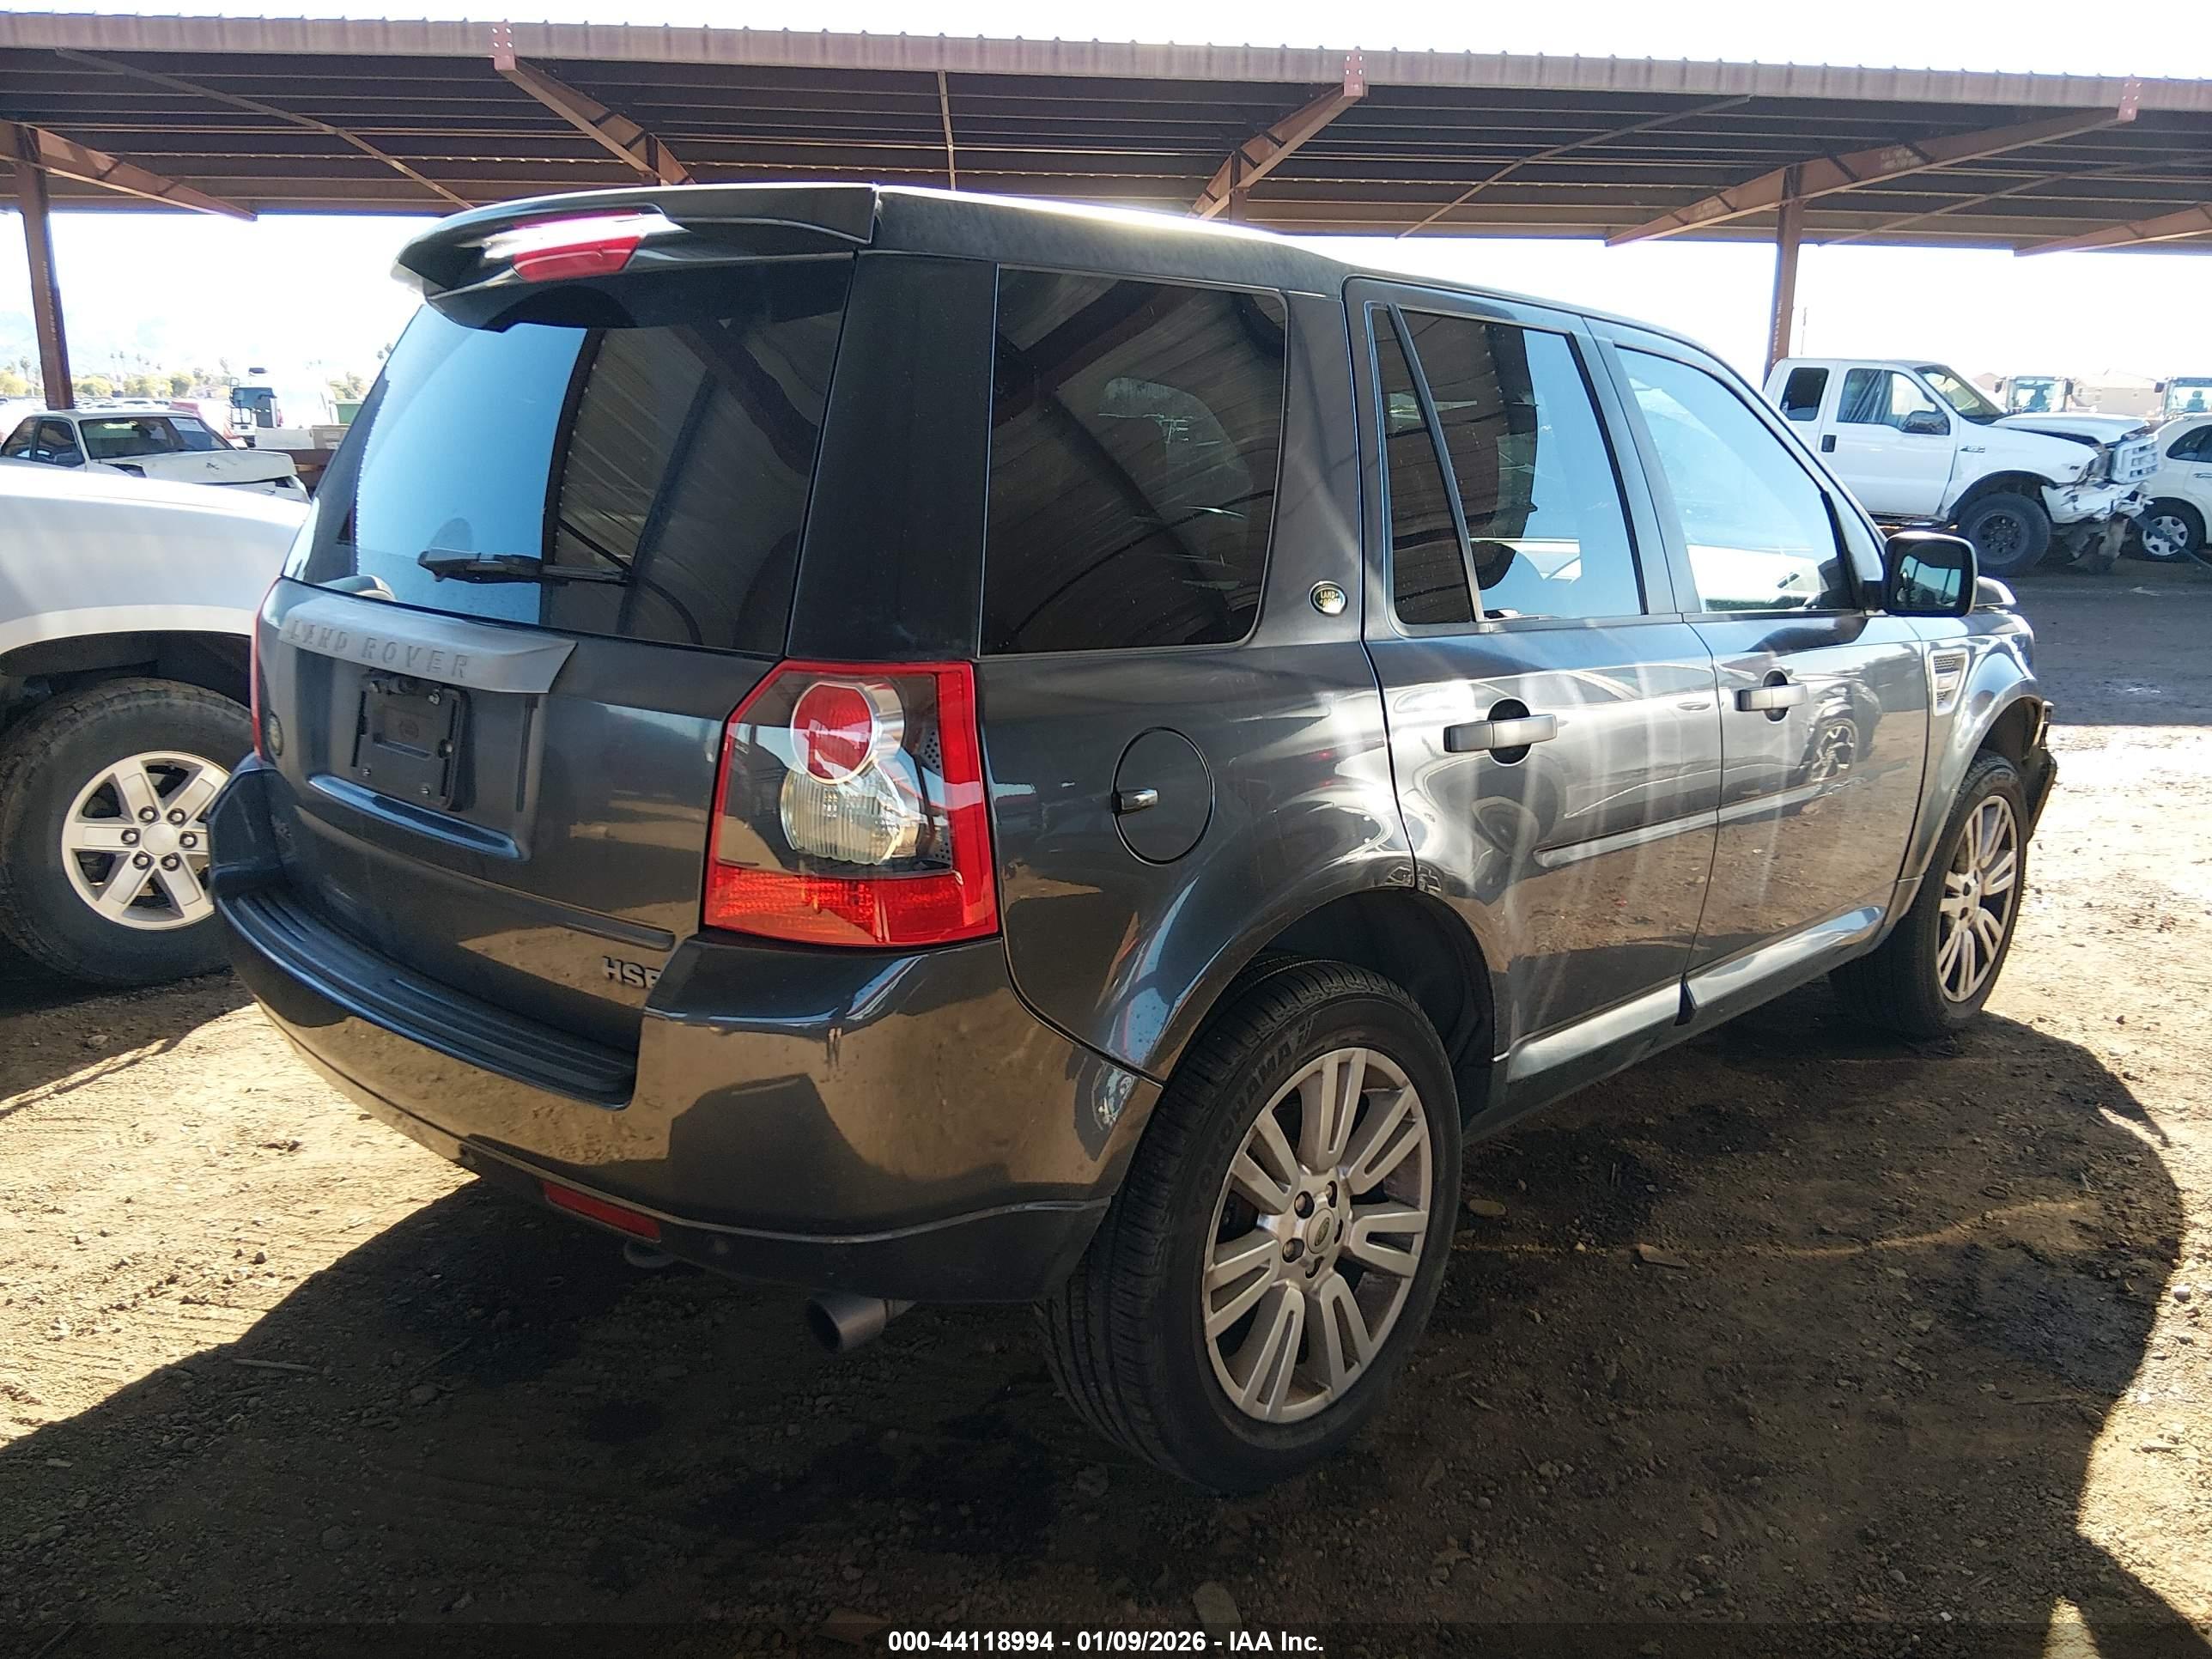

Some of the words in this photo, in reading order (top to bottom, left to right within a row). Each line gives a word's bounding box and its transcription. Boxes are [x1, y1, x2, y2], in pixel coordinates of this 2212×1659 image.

[1320, 590, 1335, 599] LAND
[289, 619, 349, 651] LAND
[361, 636, 469, 678] ROVER
